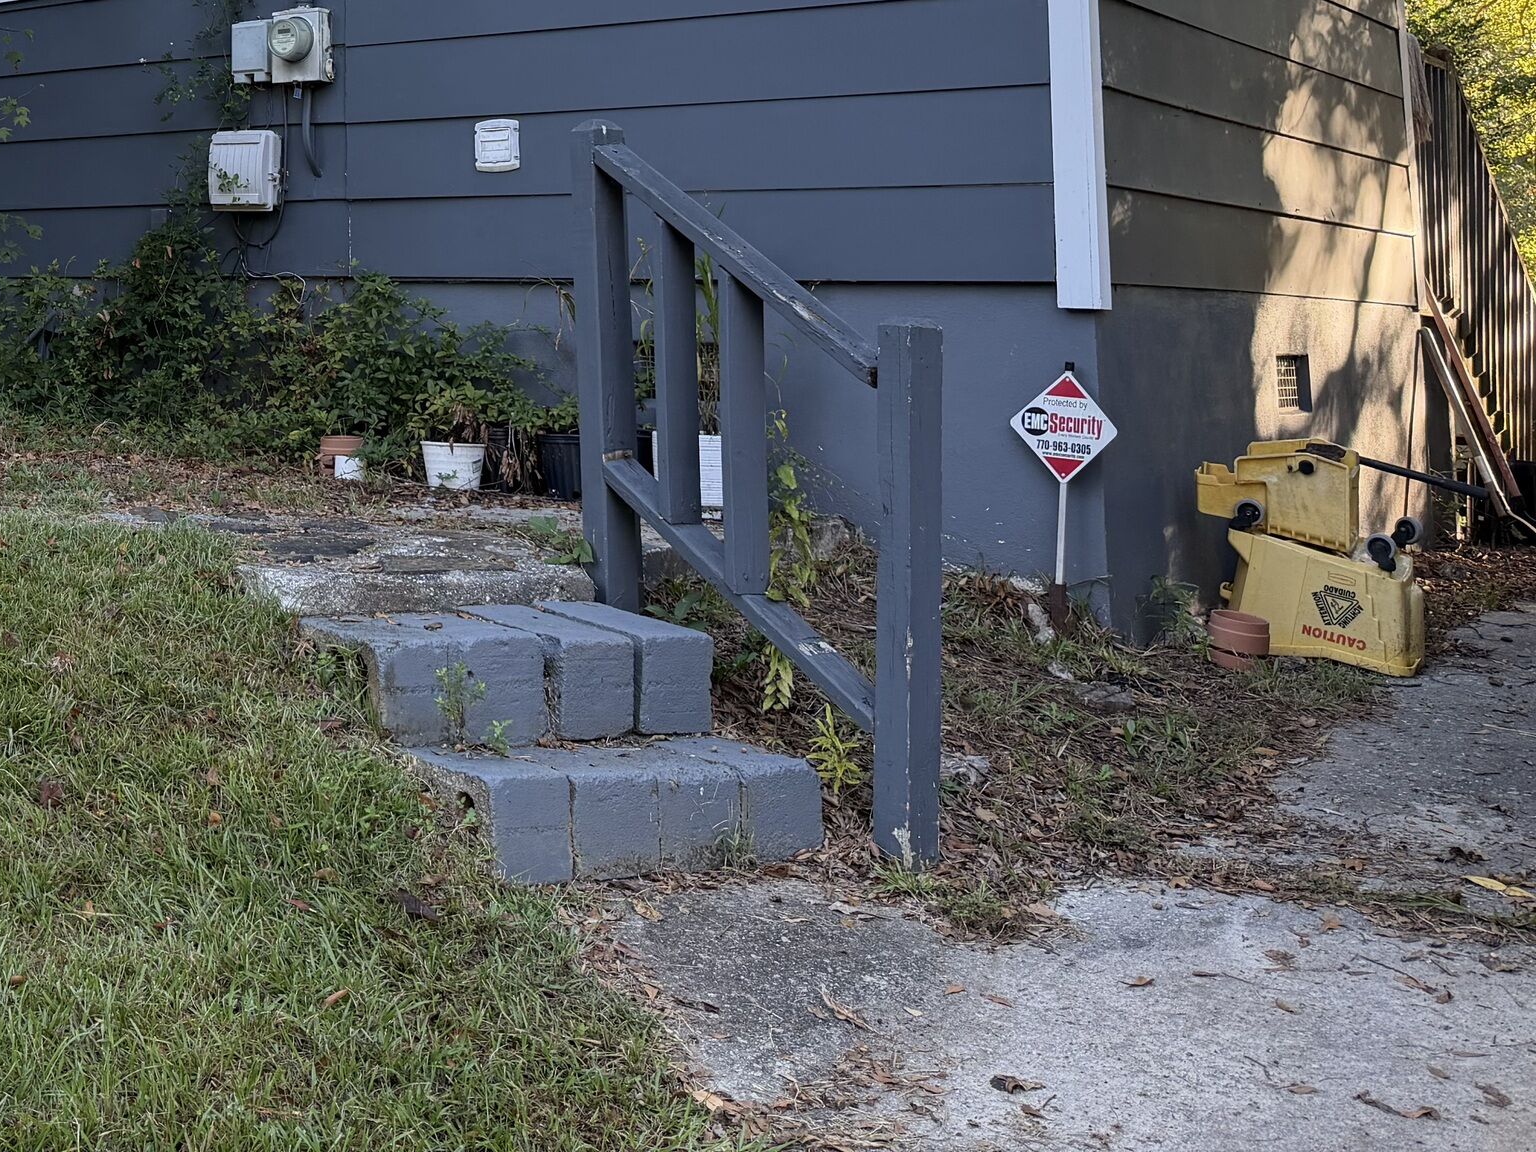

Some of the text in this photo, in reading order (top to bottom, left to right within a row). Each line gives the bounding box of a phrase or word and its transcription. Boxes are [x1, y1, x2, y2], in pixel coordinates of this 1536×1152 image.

[1043, 397, 1088, 411] Protected by
[1024, 412, 1103, 440] EMC Security
[1036, 439, 1091, 455] 770-963-0305
[1323, 584, 1356, 599] CUIDADO
[1311, 591, 1332, 626] ATTENTION
[1338, 604, 1364, 629] ACHTUNG
[1301, 624, 1367, 651] CAUTION
